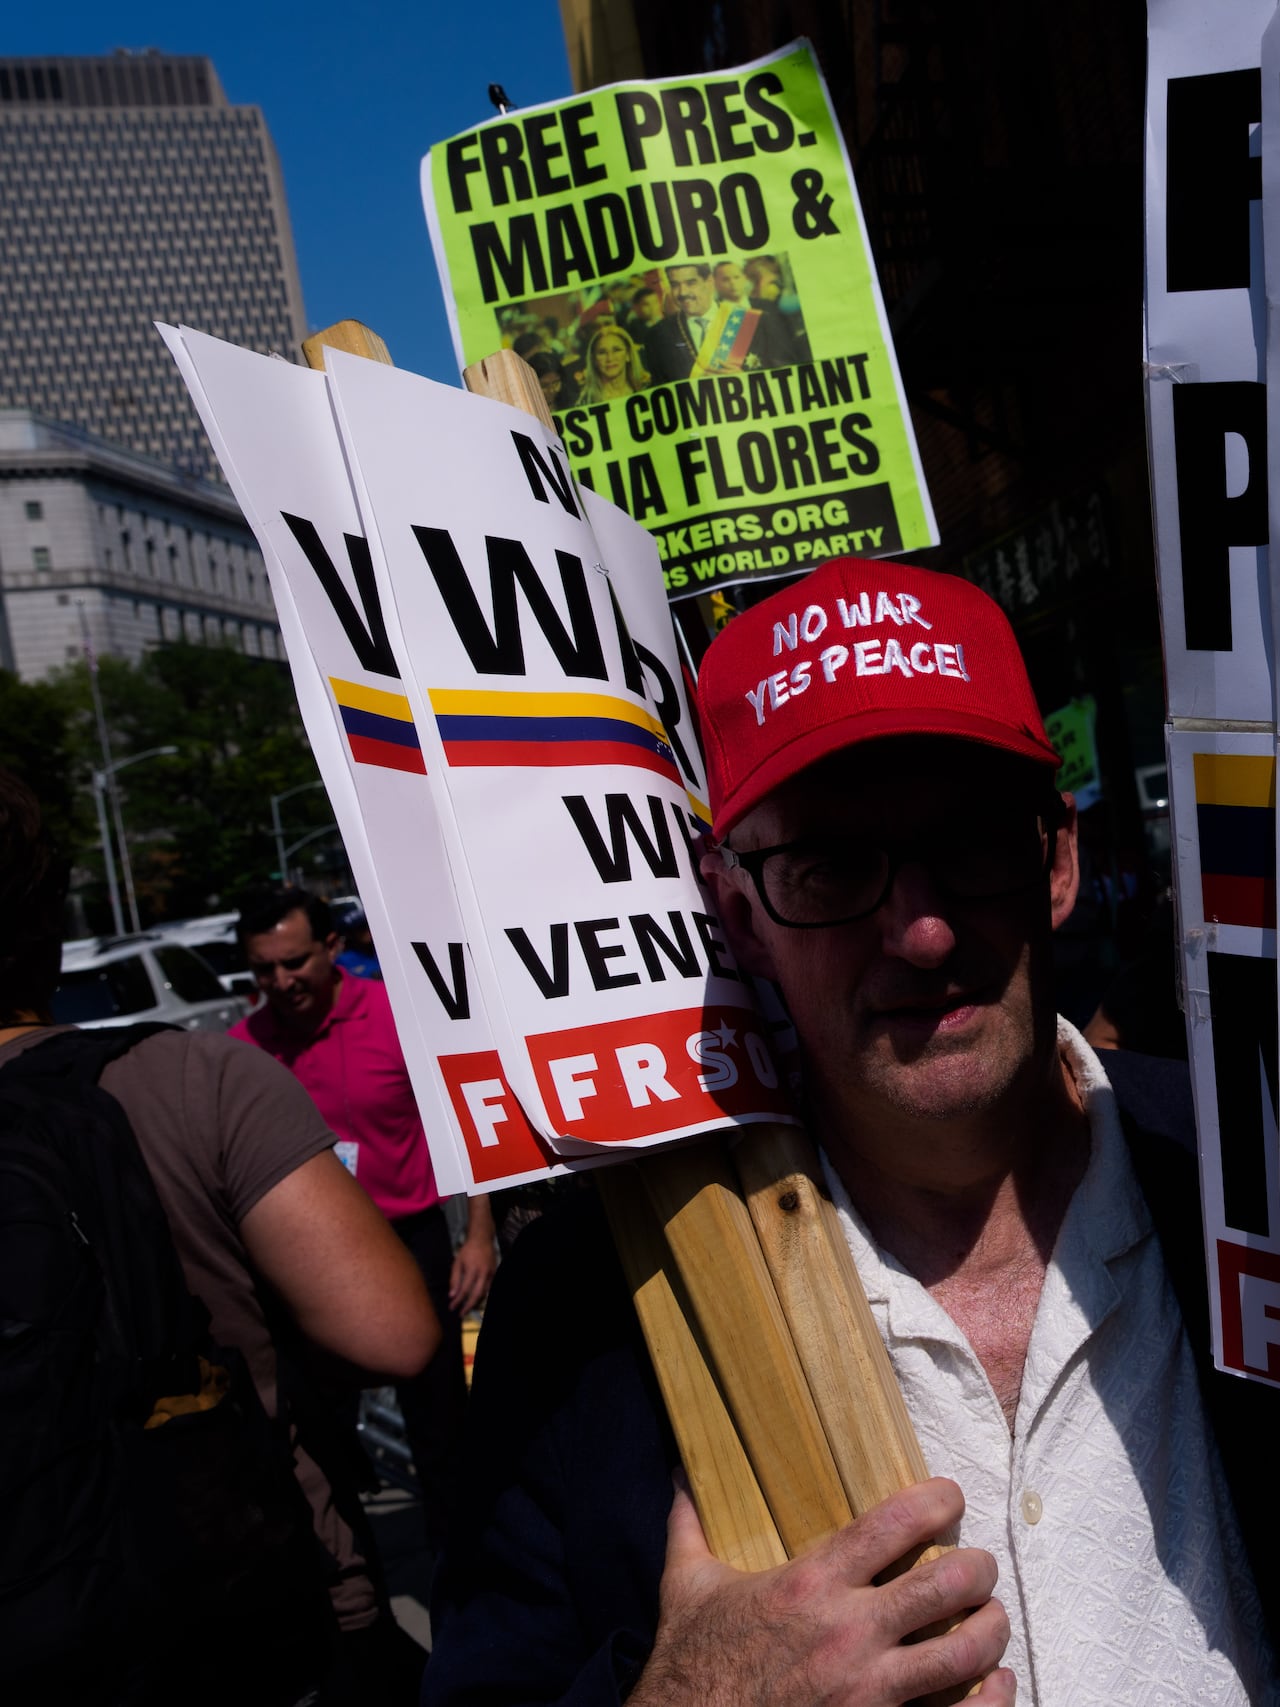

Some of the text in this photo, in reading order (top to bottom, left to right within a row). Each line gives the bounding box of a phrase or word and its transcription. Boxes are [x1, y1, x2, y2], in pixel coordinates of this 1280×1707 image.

[446, 72, 816, 214] FREE PRES.
[469, 168, 841, 304] MADURO &
[626, 353, 871, 443] COMBATANT
[675, 412, 881, 508] FLORES
[692, 546, 790, 580] WORLD
[793, 526, 884, 562] PARTY
[773, 591, 933, 656] NO WAR
[745, 638, 971, 726] YES PEACE!
[504, 911, 750, 999] VENE
